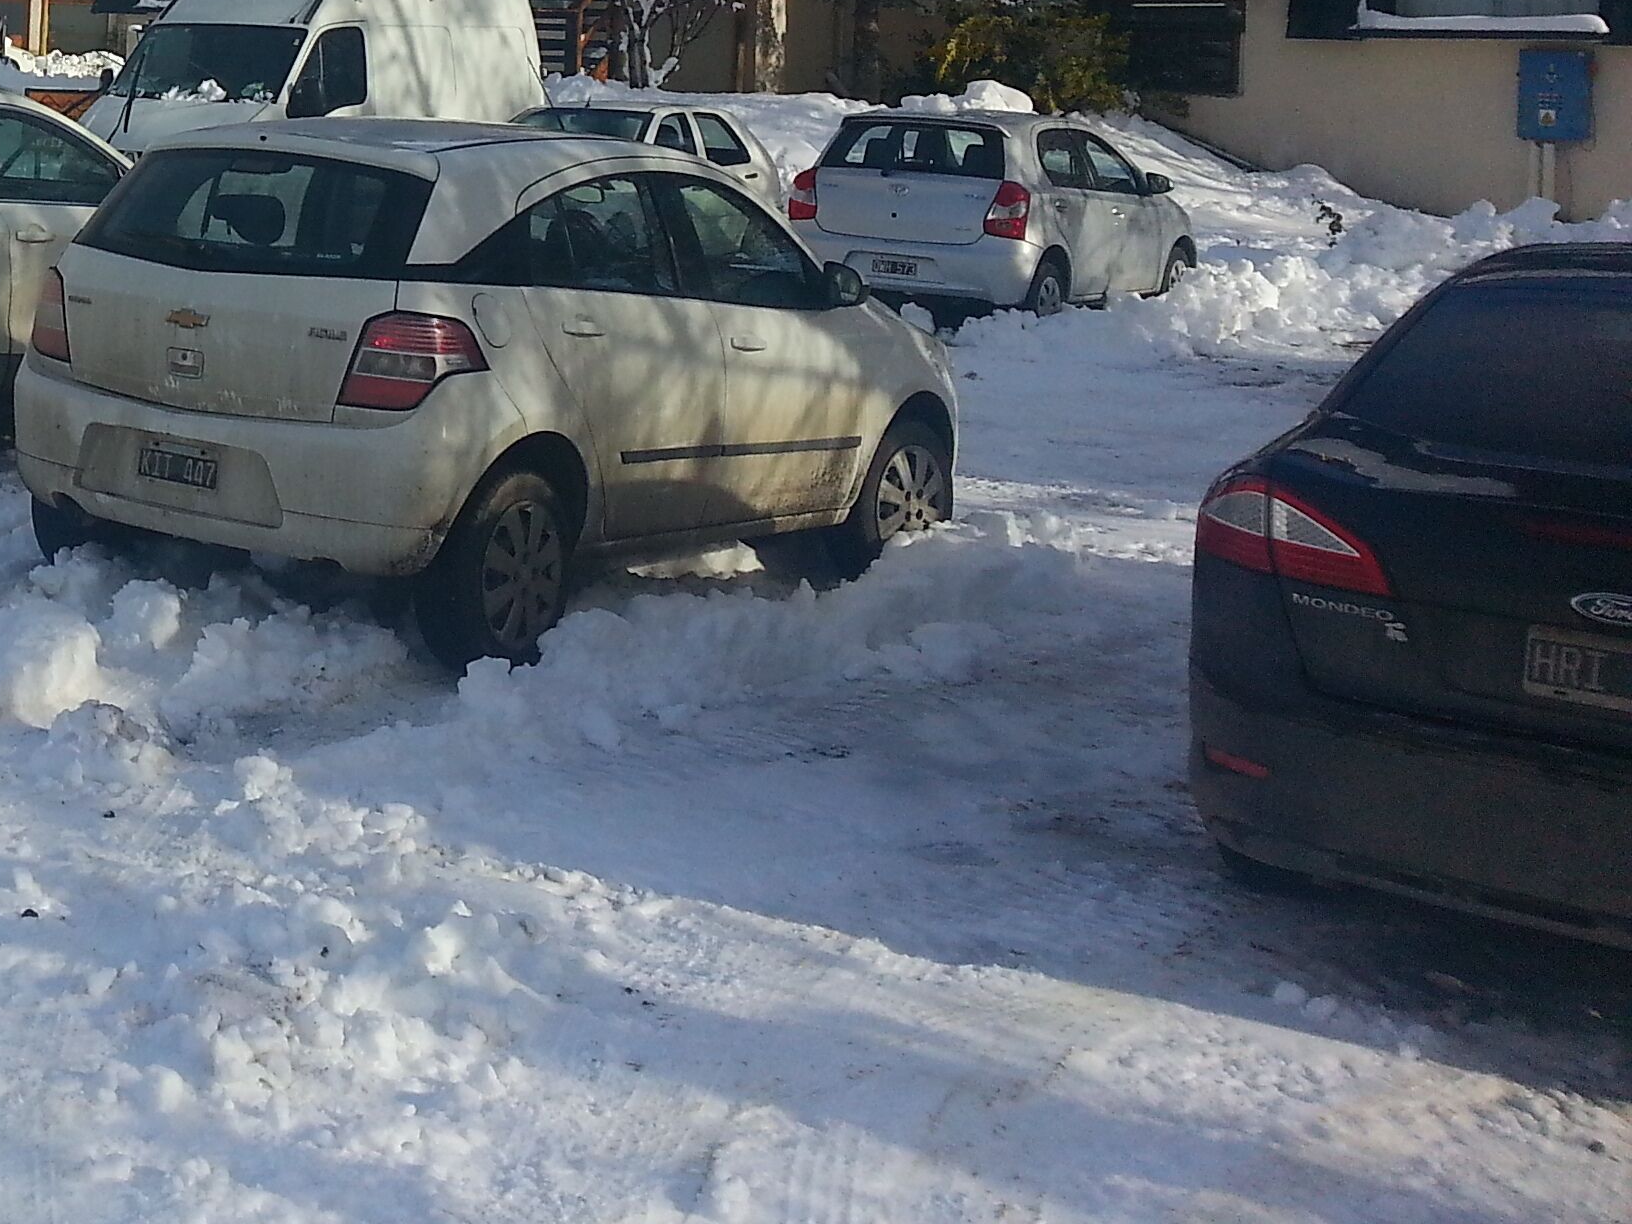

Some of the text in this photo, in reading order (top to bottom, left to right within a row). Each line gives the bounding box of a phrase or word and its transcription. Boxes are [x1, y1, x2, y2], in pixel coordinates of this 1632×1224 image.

[140, 449, 216, 487] KIT 447
[1291, 592, 1394, 622] MONDEO
[1532, 643, 1608, 691] HRI
